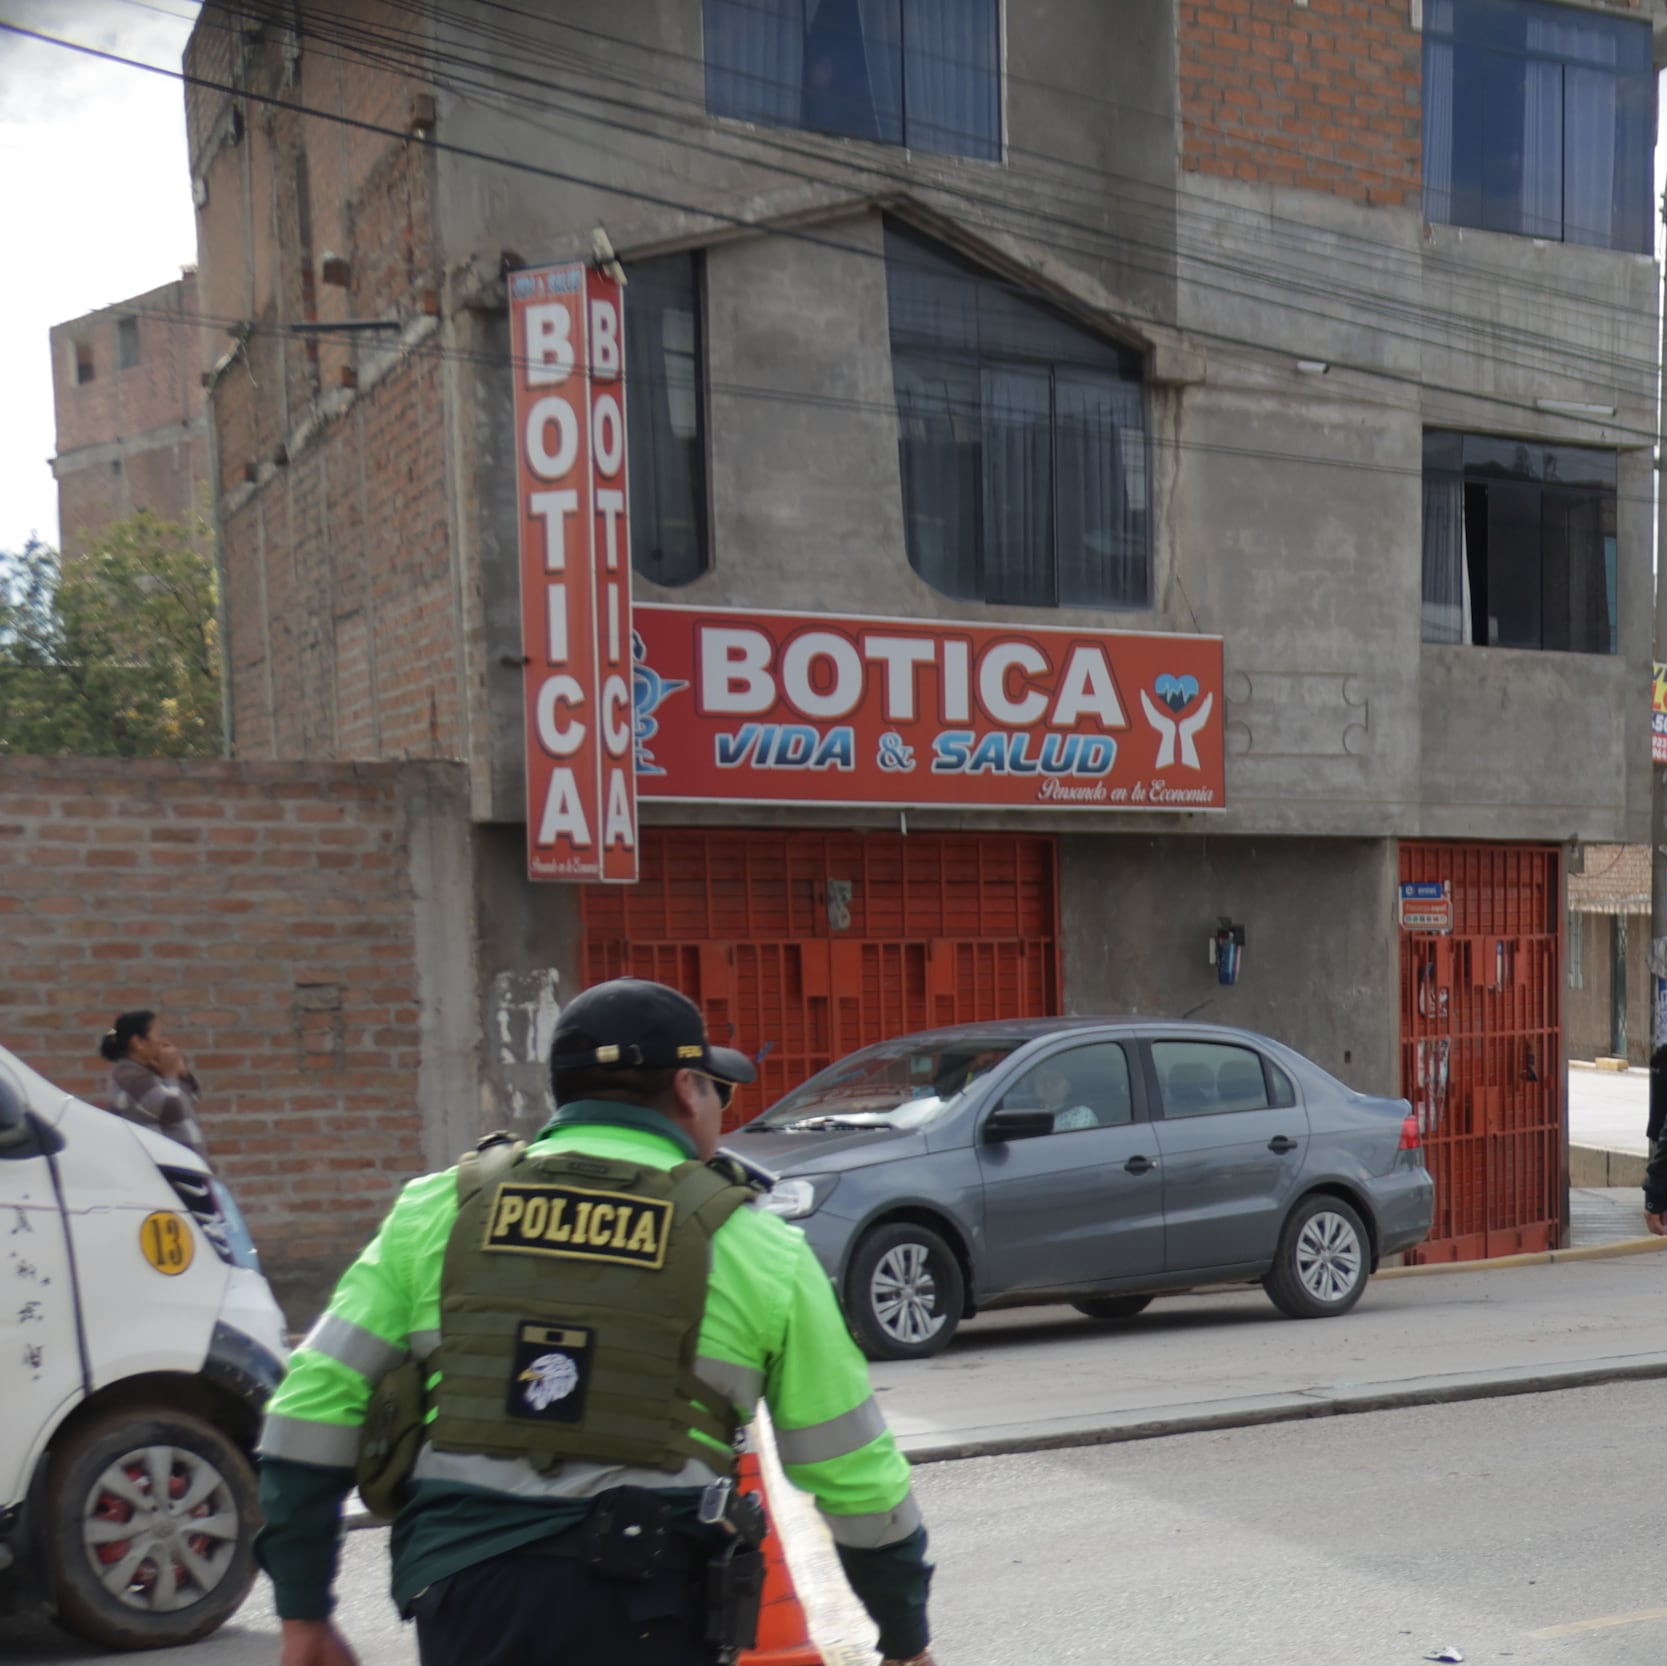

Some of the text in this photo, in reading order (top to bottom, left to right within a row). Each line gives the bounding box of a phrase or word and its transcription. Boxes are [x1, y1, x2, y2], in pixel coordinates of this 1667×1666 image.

[525, 302, 592, 845] BOTICA
[590, 299, 635, 847] BOTICA
[699, 625, 1128, 729] BOTICA
[714, 722, 1118, 777] VIDA & SALUD
[151, 1218, 184, 1266] 13
[493, 1195, 657, 1254] POLICIA
